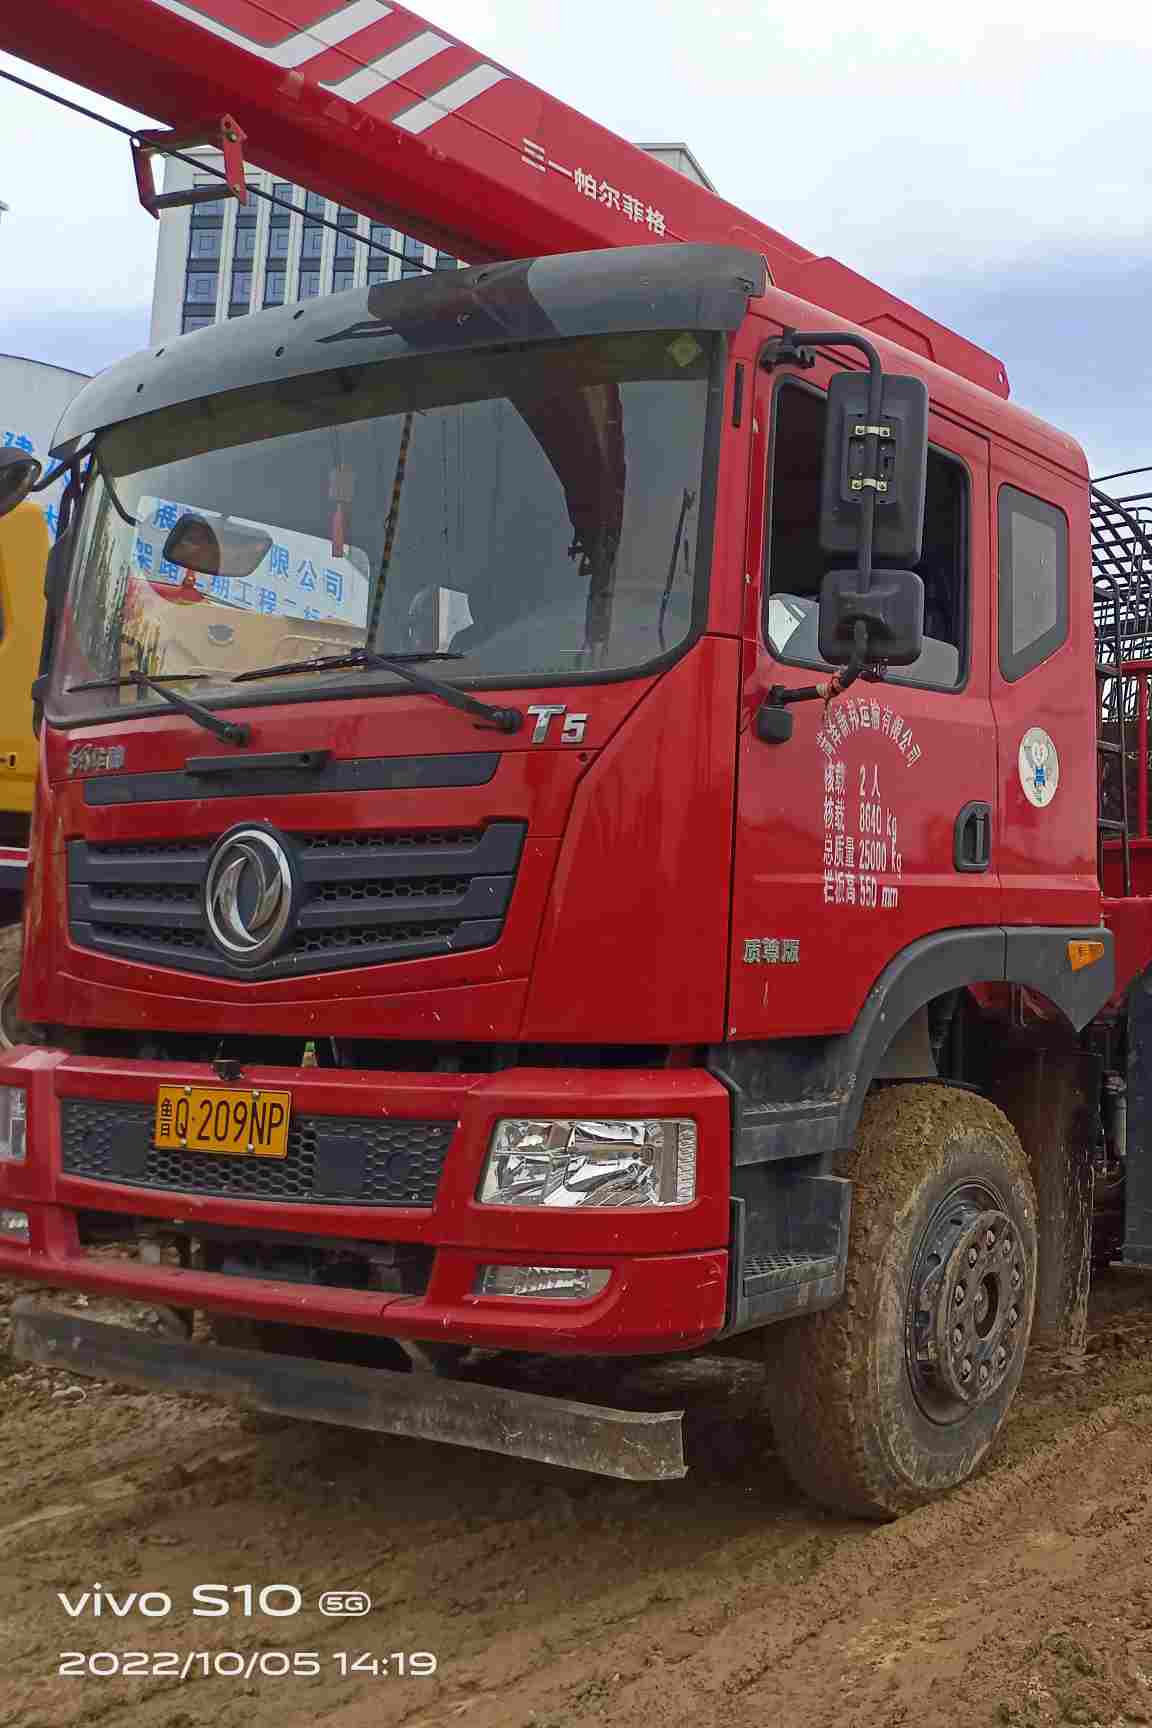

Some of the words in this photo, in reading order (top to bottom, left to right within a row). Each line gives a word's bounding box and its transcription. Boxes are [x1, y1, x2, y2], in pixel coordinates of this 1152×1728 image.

[521, 137, 666, 237] 三一帕尔菲格
[527, 704, 588, 744] T5
[859, 764, 867, 797] 2
[886, 807, 898, 843] kg
[859, 839, 887, 873] 25000
[890, 840, 903, 881] kg
